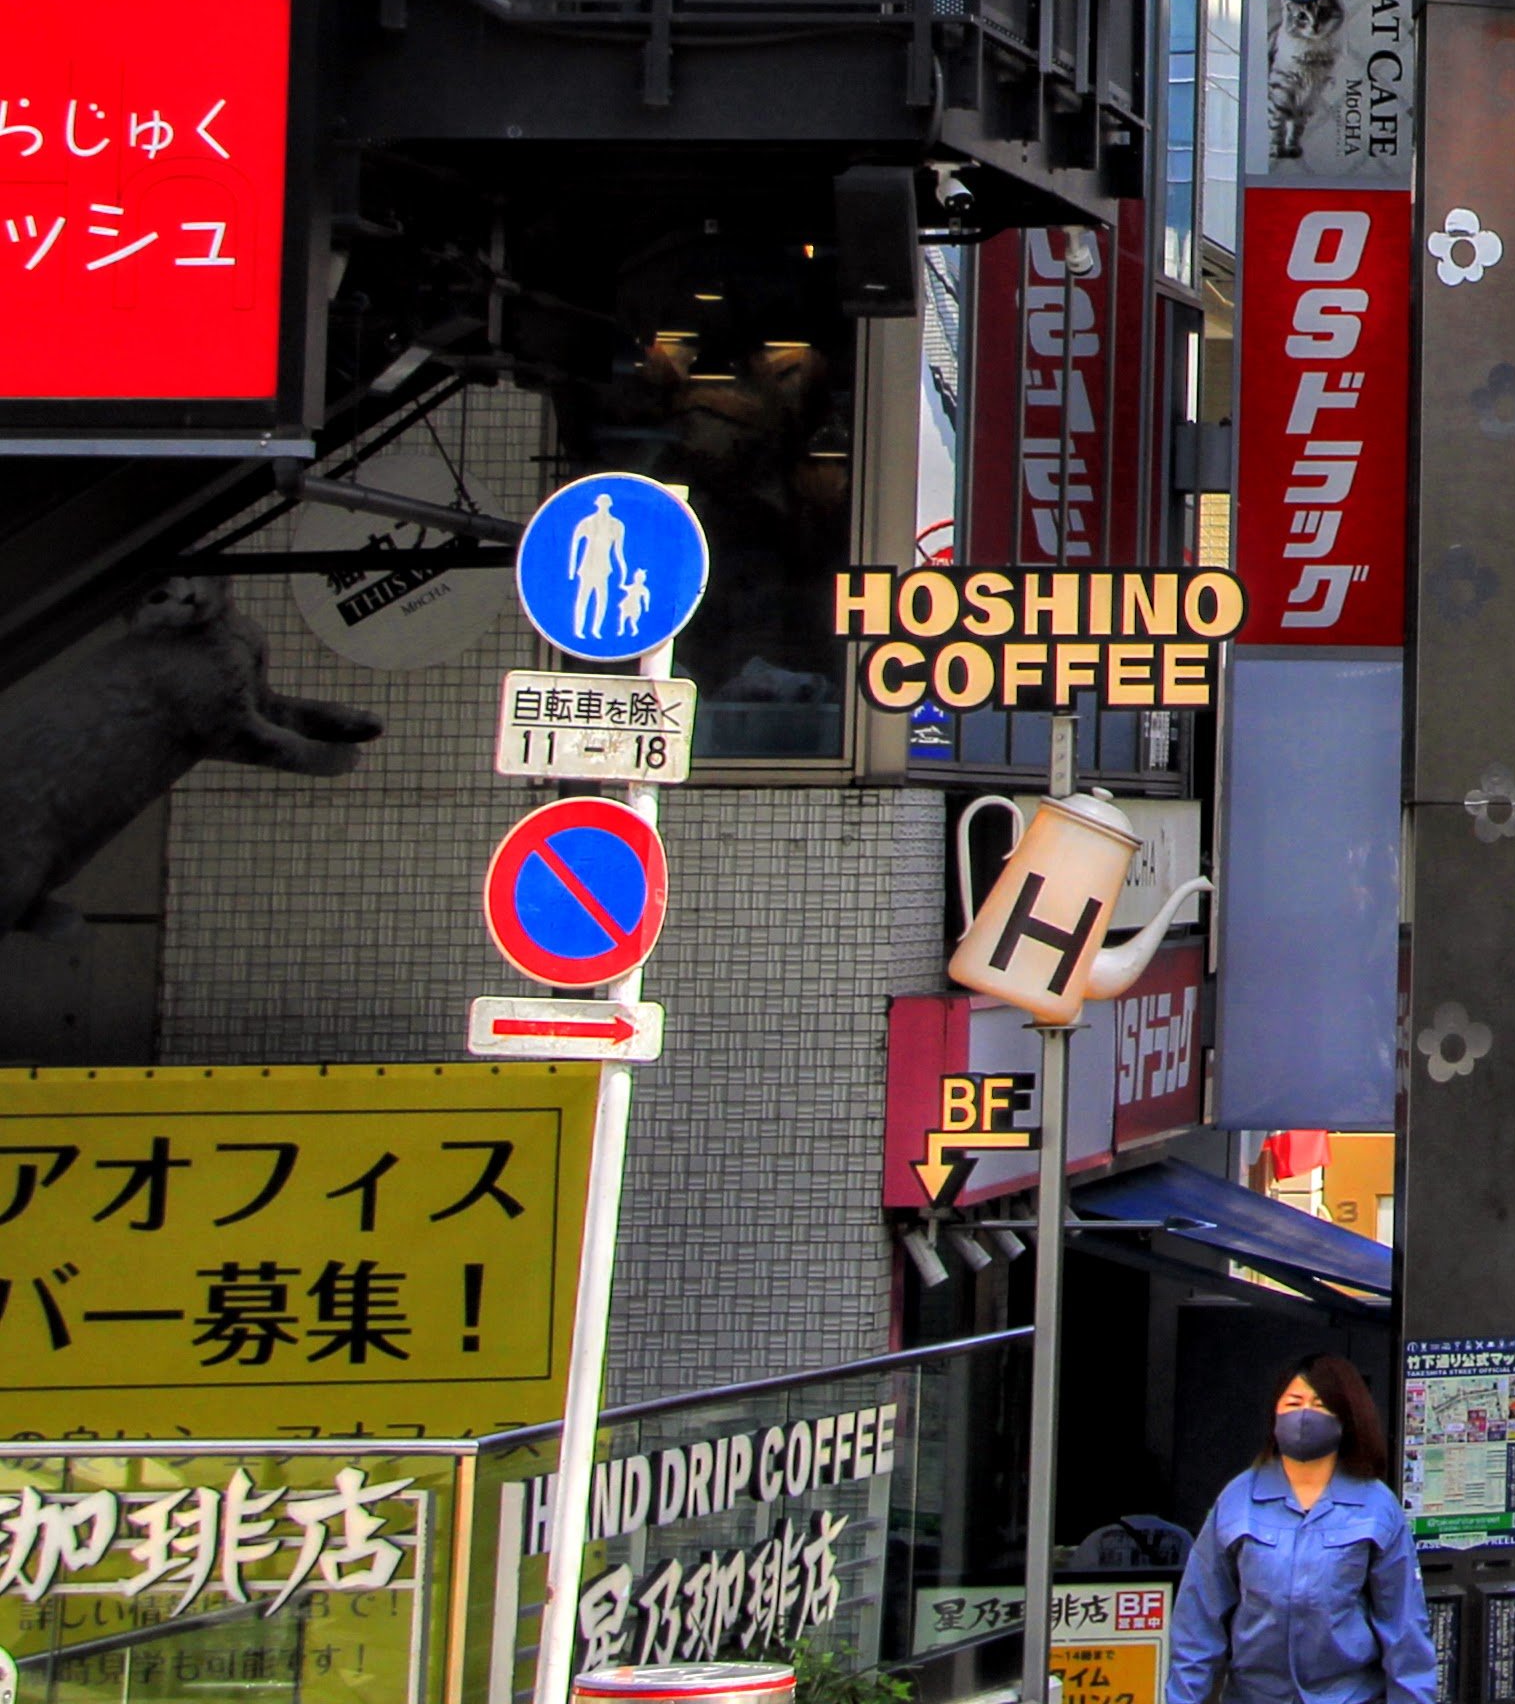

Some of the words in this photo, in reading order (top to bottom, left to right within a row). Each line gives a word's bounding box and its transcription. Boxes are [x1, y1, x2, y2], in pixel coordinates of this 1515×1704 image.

[1366, 50, 1403, 158] CAFE
[1281, 210, 1372, 629] OSドラッグ
[834, 572, 1245, 637] HOSHINO
[513, 686, 682, 730] 自転車を除く
[867, 641, 1210, 708] COFFEE
[521, 729, 556, 768] 11
[635, 734, 667, 771] 18
[989, 873, 1103, 998] H
[942, 1079, 1015, 1133] BF
[0, 1136, 526, 1232] アオフィス
[526, 1453, 652, 1556] HND
[655, 1433, 754, 1526] DRIP
[757, 1402, 898, 1503] COFFEE
[578, 1509, 849, 1670] 星乃珈琲店
[1118, 1593, 1162, 1616] BF
